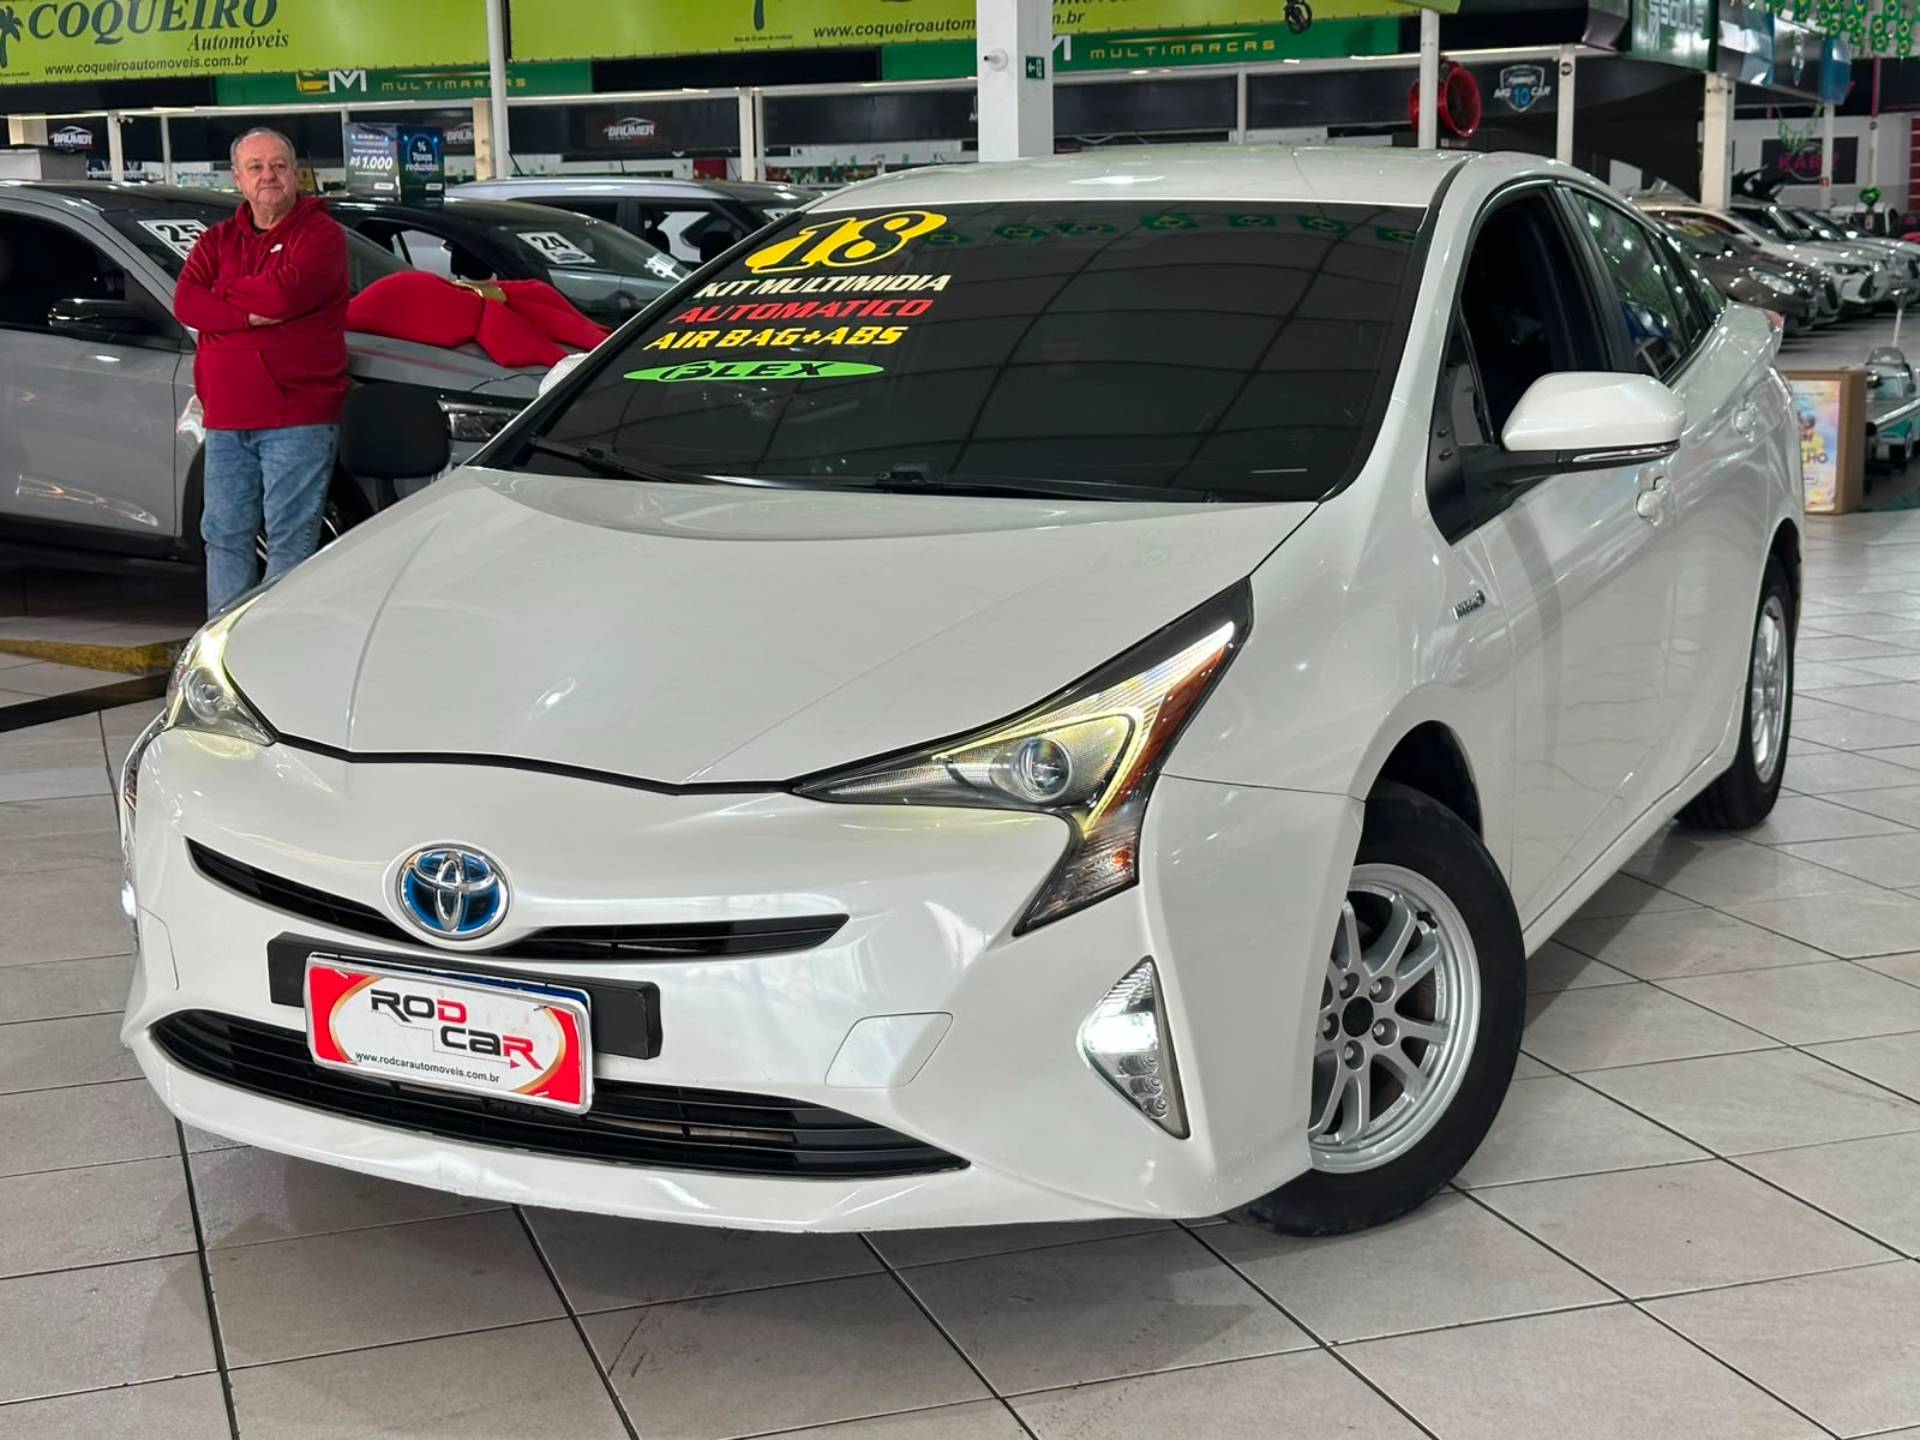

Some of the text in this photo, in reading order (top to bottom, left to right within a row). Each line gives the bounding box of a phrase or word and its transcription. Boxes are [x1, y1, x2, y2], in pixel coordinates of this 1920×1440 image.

[28, 0, 278, 45] COQUEIRO
[187, 29, 290, 52] Automóveis
[44, 55, 249, 76] www.coqueiroautomoveis.com.br
[381, 78, 528, 92] MULTIMARAS
[362, 156, 394, 170] 1.000
[155, 224, 203, 243] 25
[530, 235, 571, 251] 24
[745, 210, 948, 274] 18
[694, 280, 760, 299] KIT
[643, 330, 720, 351] AIR
[658, 360, 834, 382] FLEX
[355, 1051, 501, 1084] www.rodcarautomoveis.com.br
